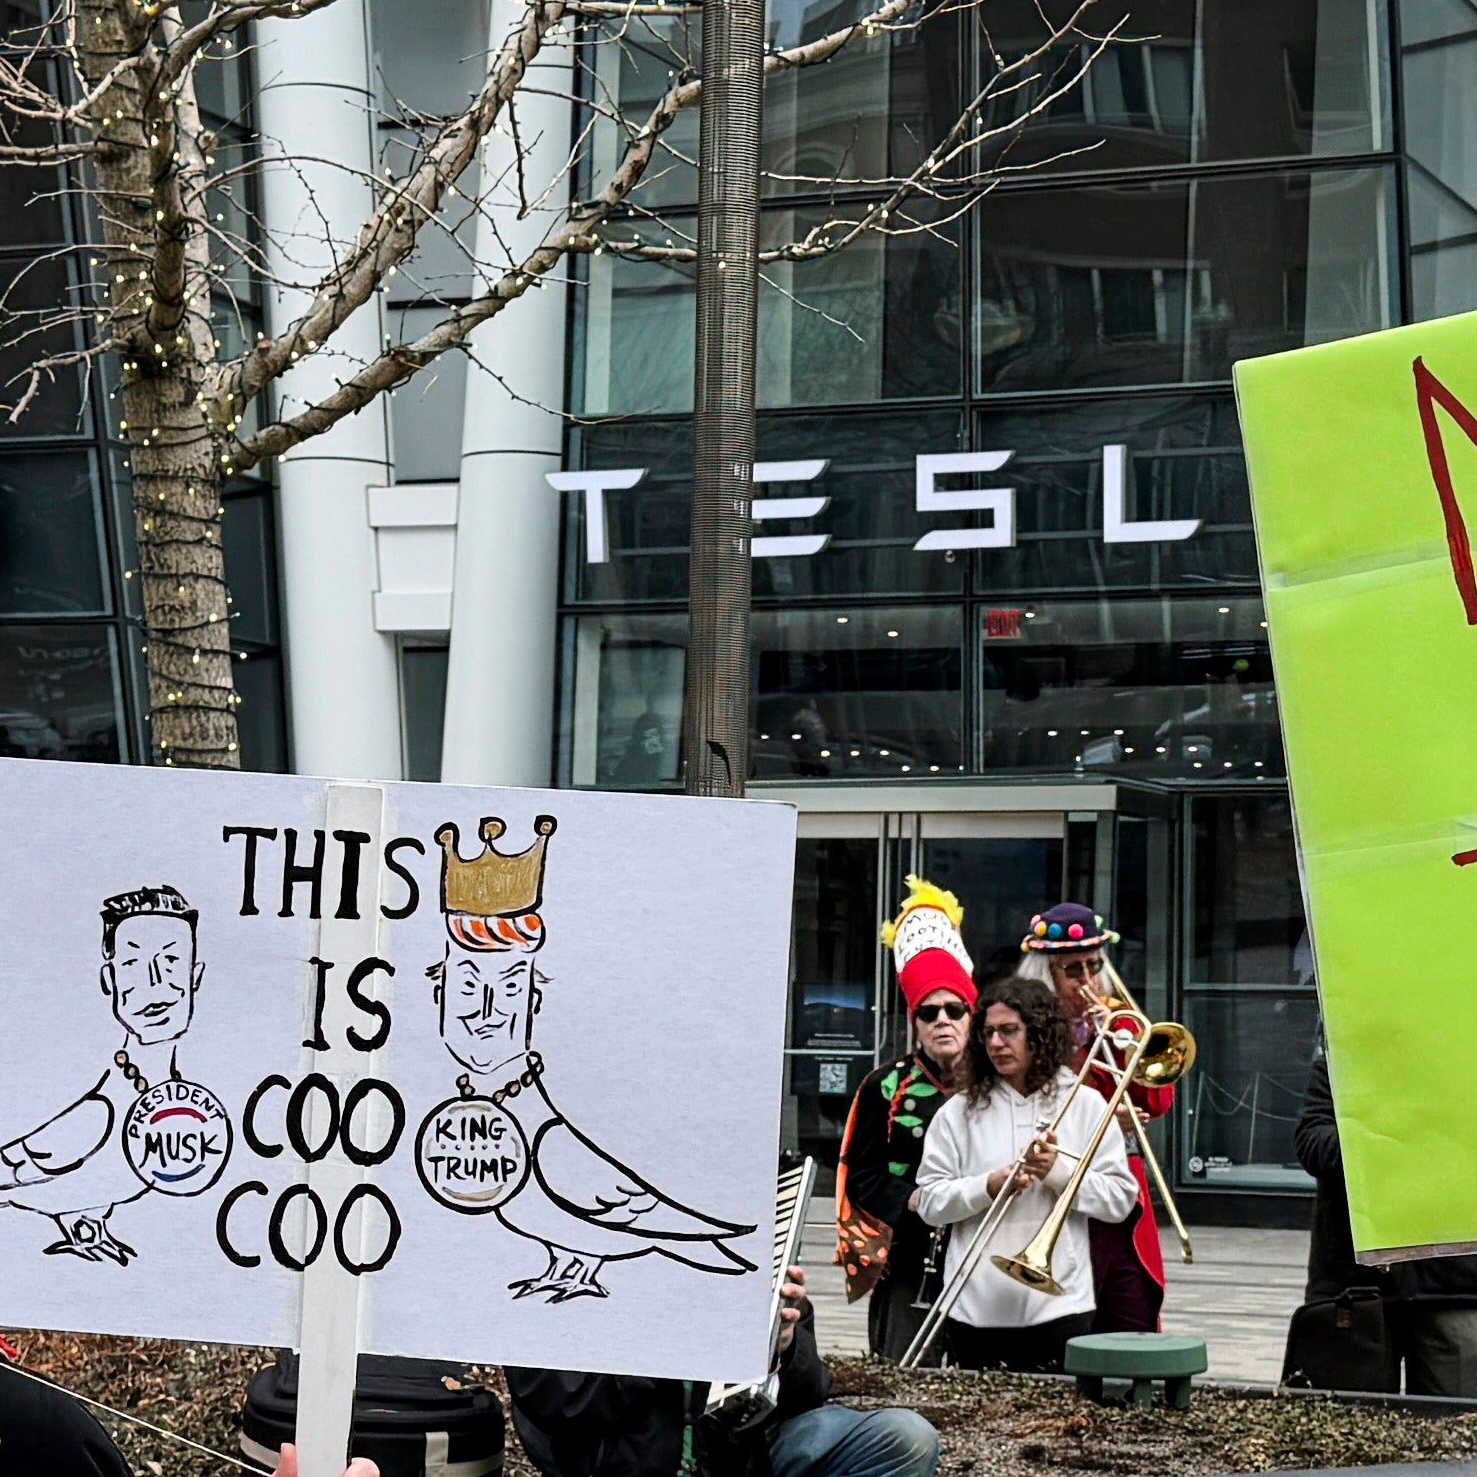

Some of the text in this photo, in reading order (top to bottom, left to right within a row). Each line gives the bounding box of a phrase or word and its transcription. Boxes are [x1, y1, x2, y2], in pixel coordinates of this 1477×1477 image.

[544, 444, 1204, 563] TESL
[222, 825, 426, 920] THIS
[302, 956, 397, 1053] IS
[129, 1081, 226, 1139] PRESIDENT
[137, 1130, 223, 1168] MUSK
[243, 1072, 406, 1167] COO
[435, 1115, 508, 1142] KING
[427, 1153, 519, 1184] TRUMP
[216, 1181, 402, 1276] COO
